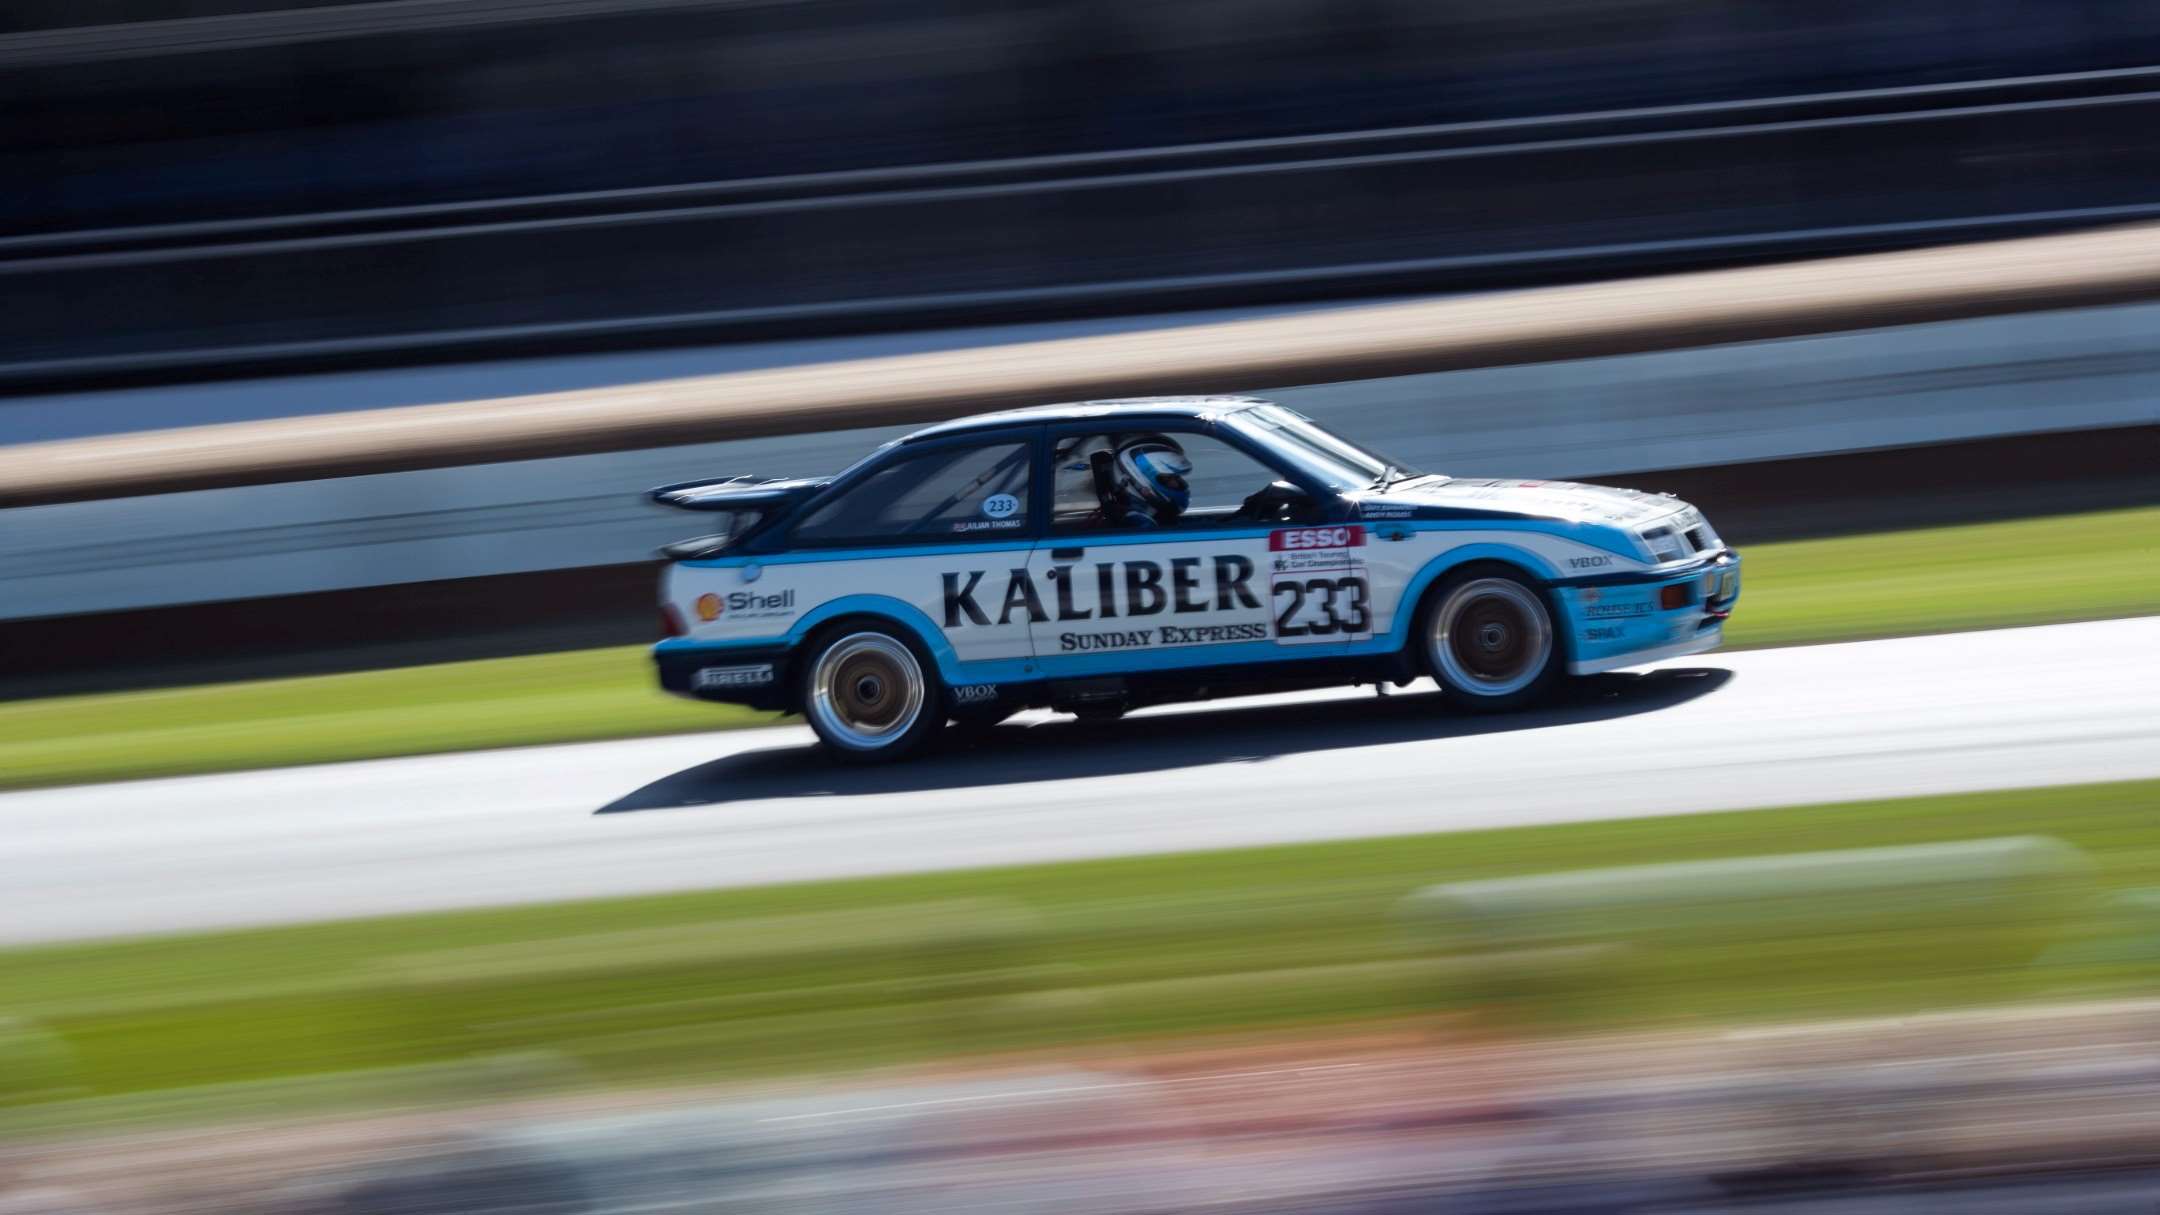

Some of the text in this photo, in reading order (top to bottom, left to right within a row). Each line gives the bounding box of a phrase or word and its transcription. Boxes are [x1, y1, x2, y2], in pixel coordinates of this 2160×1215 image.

[990, 500, 1013, 512] 233
[992, 519, 1021, 529] THOMAS
[1284, 526, 1352, 549] ESSO
[1569, 555, 1614, 568] VBOX
[728, 589, 796, 610] Shell
[941, 554, 1264, 628] KALIBER
[1273, 577, 1372, 637] 233
[1060, 623, 1267, 651] SUNDAY EXPRESS
[954, 684, 998, 698] VBOX
